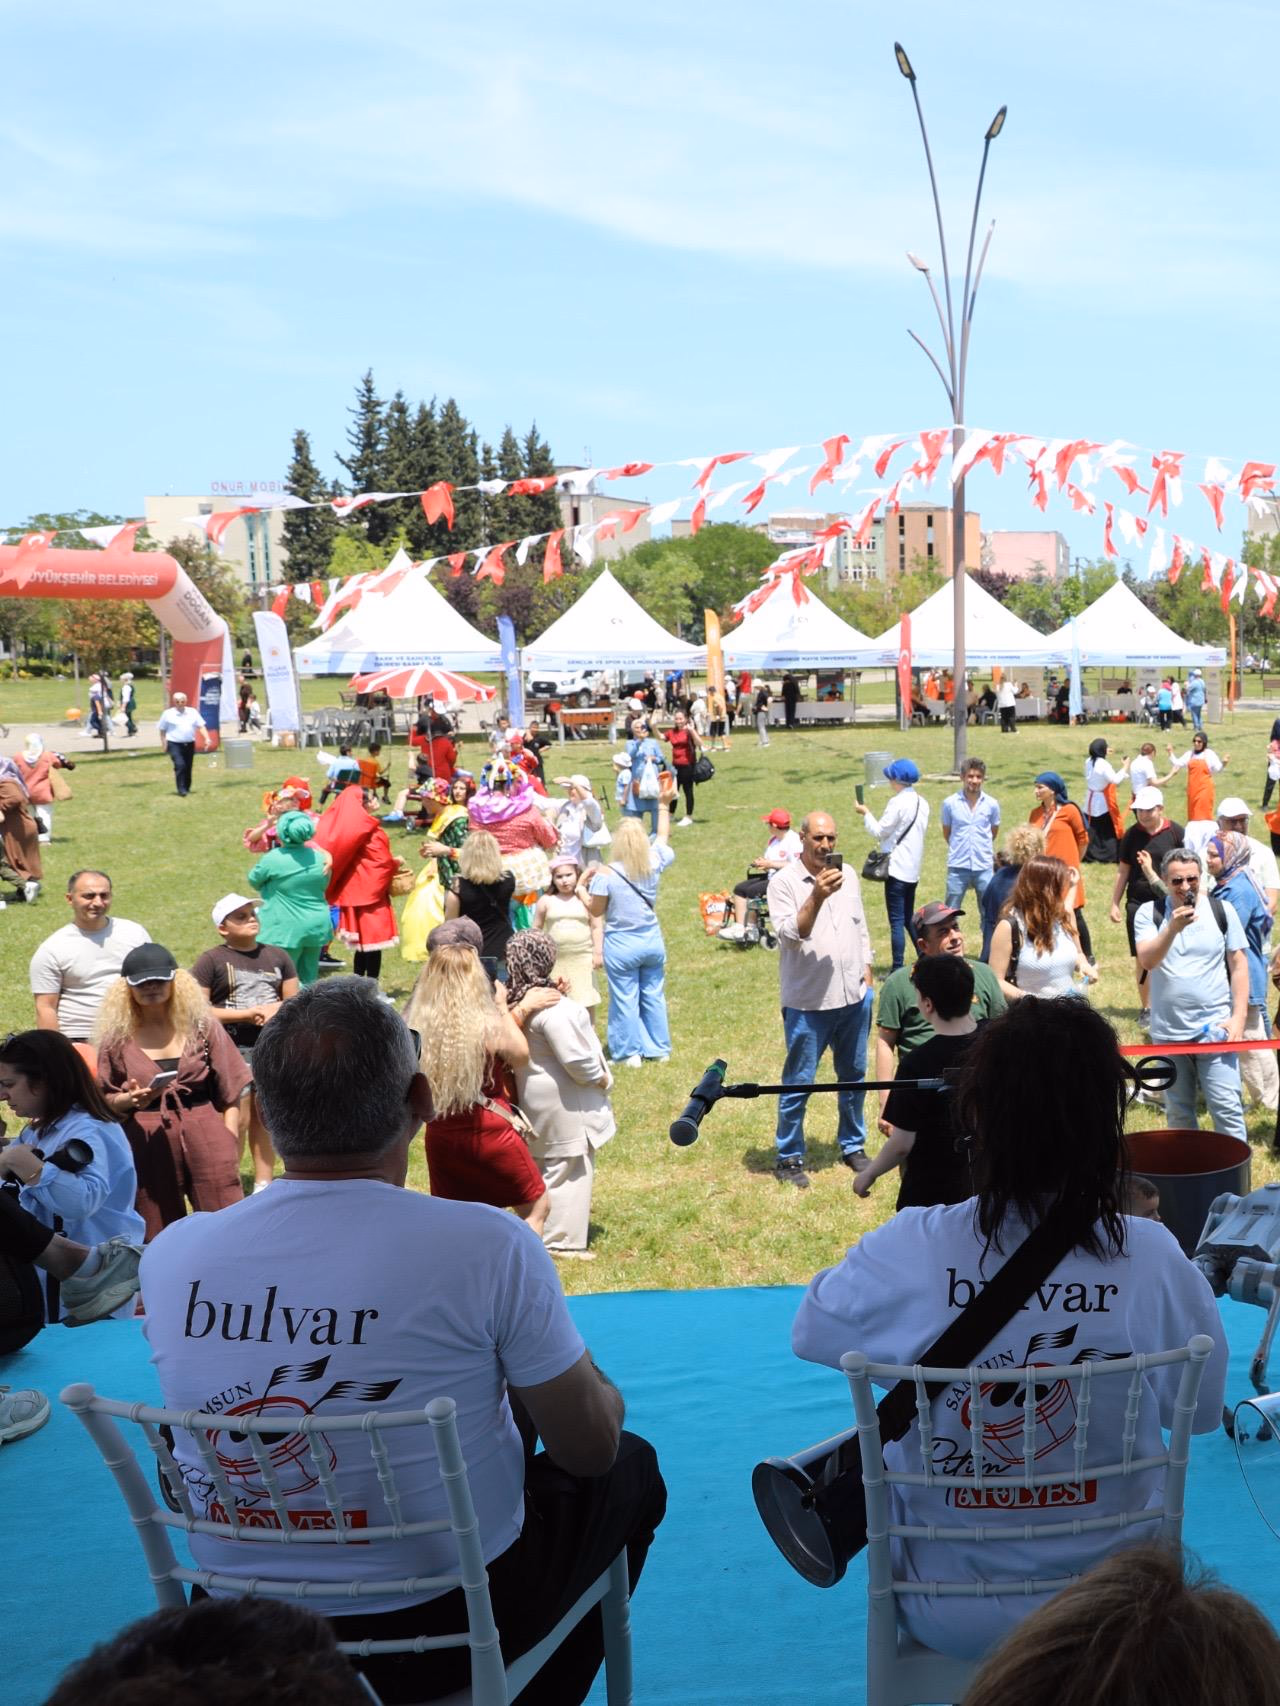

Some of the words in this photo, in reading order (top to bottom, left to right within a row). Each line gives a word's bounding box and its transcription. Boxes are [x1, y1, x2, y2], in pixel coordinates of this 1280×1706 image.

[211, 481, 244, 492] ONUR
[250, 481, 287, 492] MOBİ
[98, 572, 158, 586] BELEDİYESİ
[184, 1280, 379, 1345] bulvar
